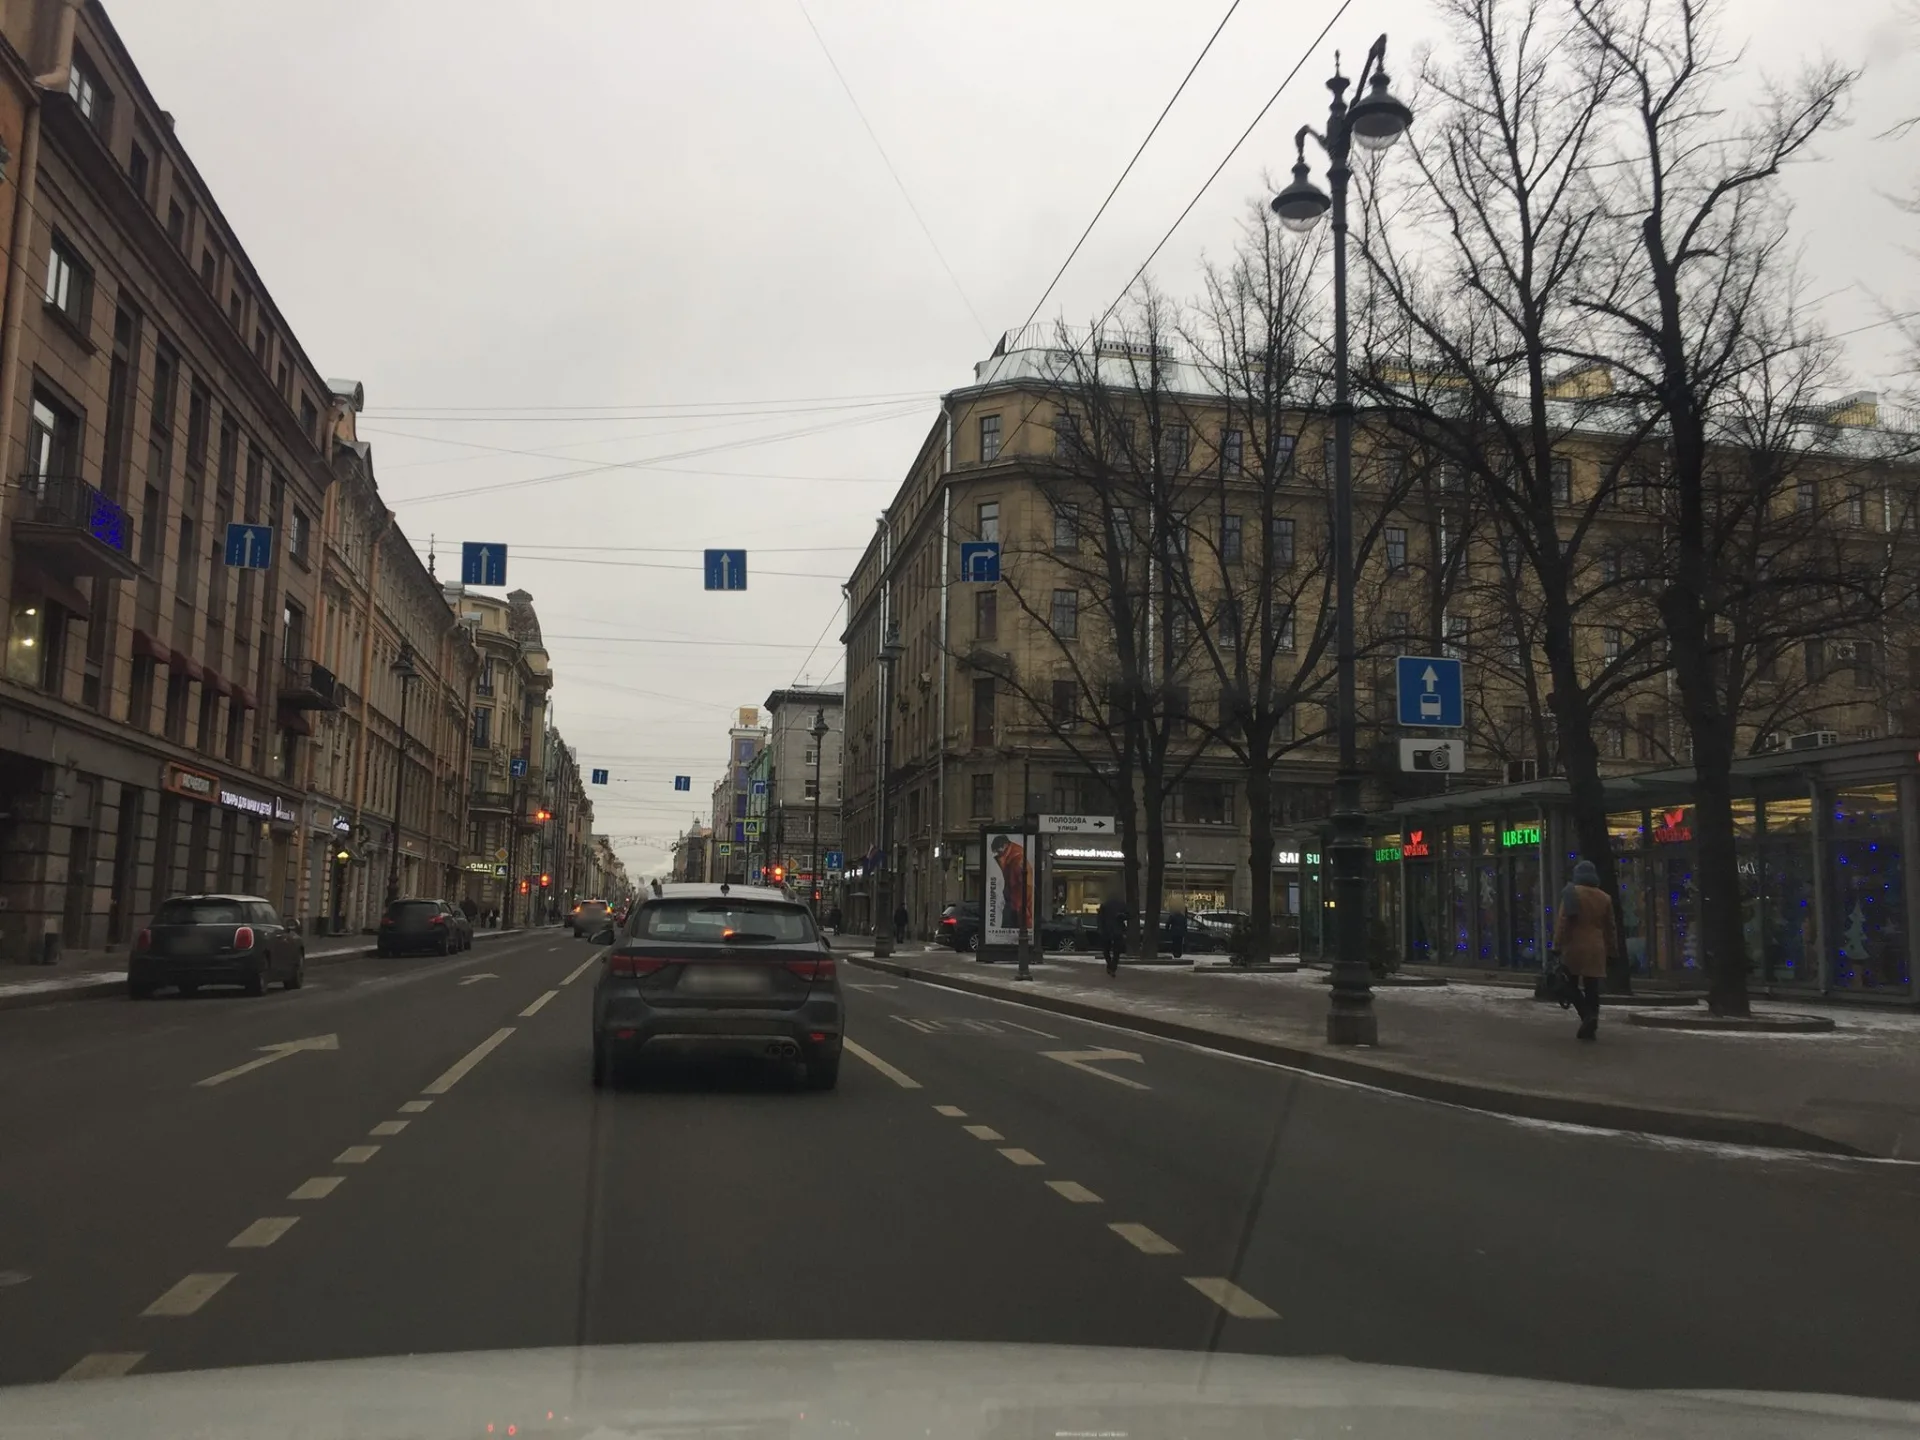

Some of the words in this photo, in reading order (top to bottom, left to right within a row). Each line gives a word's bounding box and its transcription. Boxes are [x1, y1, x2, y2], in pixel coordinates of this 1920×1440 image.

[1048, 816, 1087, 824] ПОЛОЗОВА
[1502, 828, 1540, 847] ЦВЕТЫ
[1375, 848, 1401, 862] ЦВЕТЫ
[989, 876, 997, 926] PARAJUMPERS
